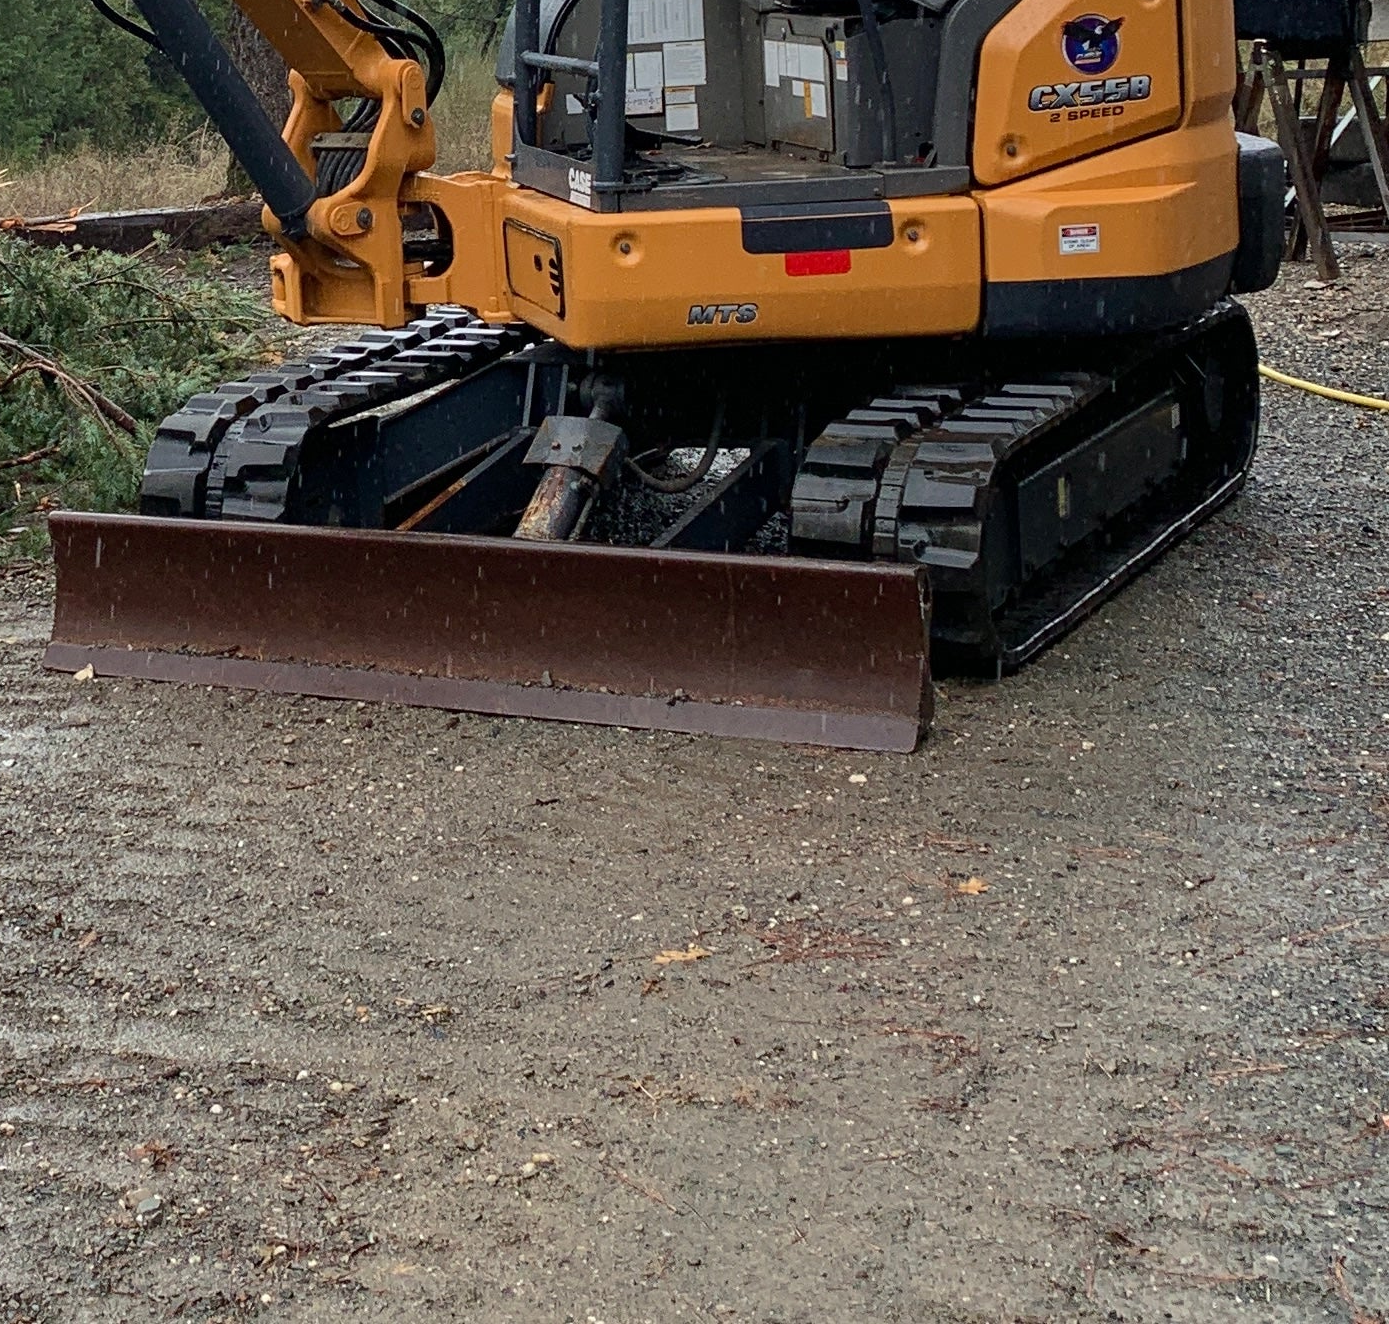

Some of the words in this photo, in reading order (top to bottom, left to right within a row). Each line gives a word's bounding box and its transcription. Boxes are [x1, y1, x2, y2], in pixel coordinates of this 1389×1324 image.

[1028, 75, 1152, 111] CX55B
[1050, 113, 1061, 123] 2
[1067, 106, 1125, 122] SPEED
[568, 167, 592, 195] CASE
[687, 302, 759, 325] MTS
